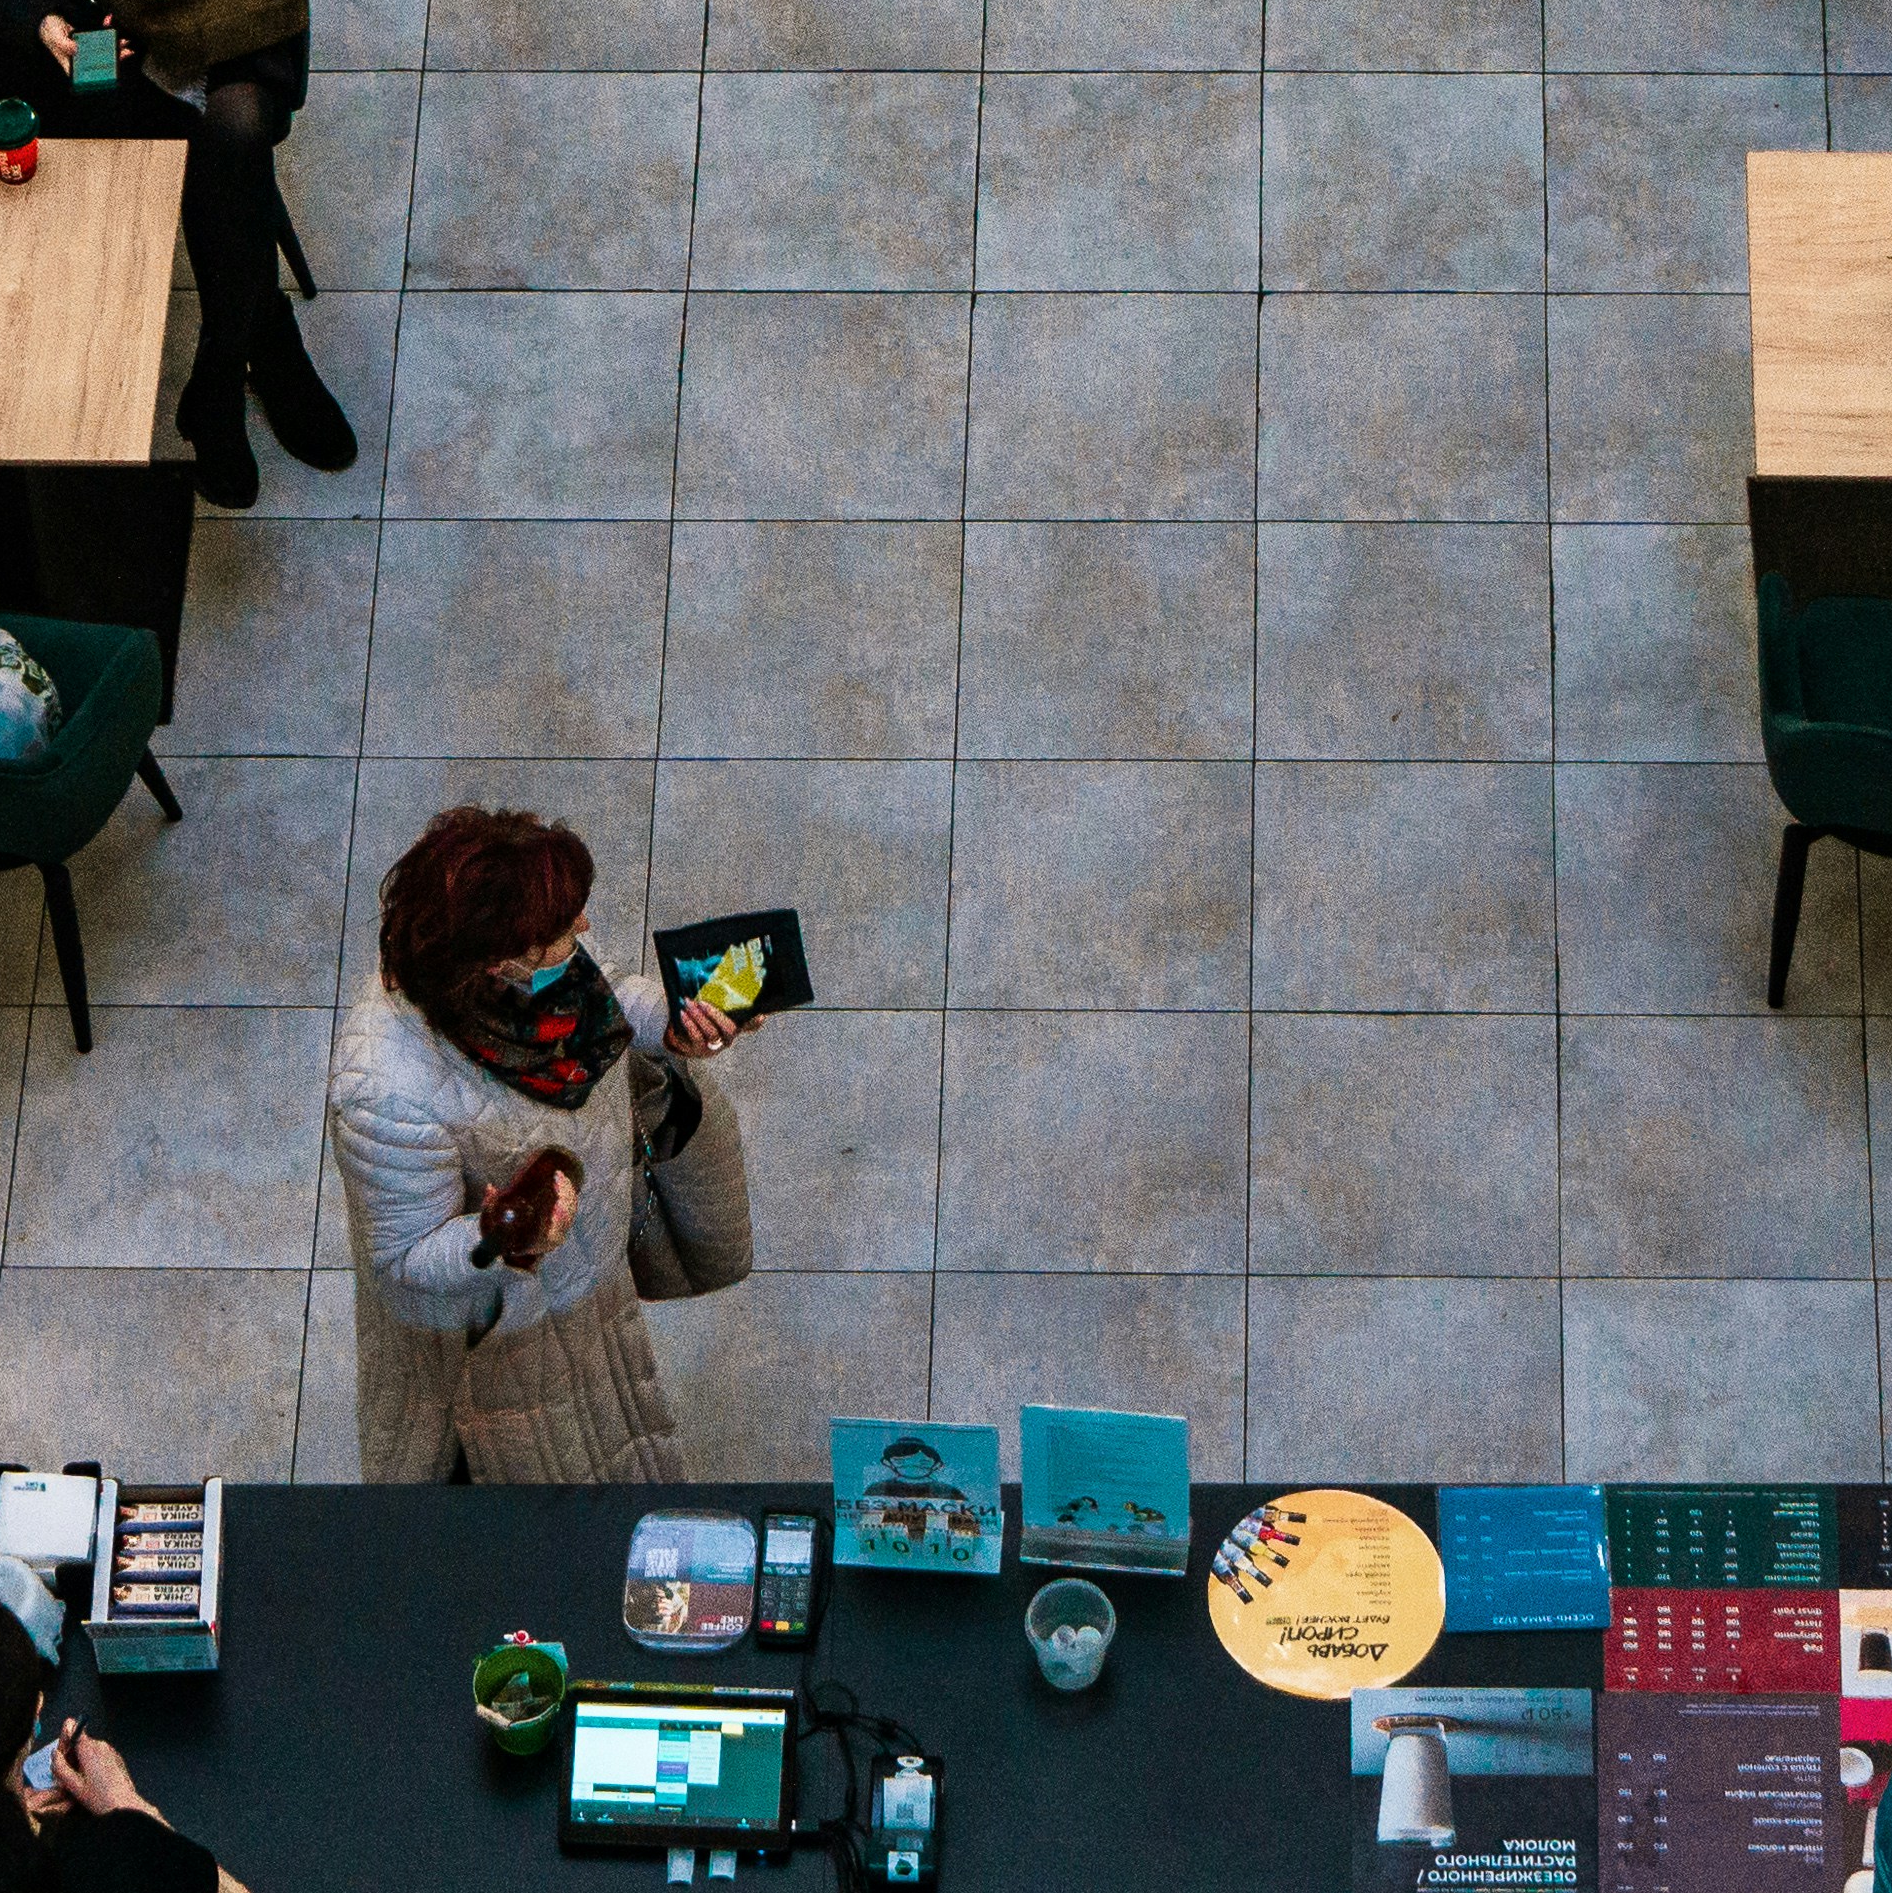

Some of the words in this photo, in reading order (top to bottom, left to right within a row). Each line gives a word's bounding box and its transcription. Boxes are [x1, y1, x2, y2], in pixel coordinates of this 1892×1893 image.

[836, 1499, 887, 1511] БЕЗ
[898, 1501, 997, 1517] МАСКИ
[161, 1512, 199, 1520] CHIKA
[164, 1540, 202, 1548] CHIKA
[1779, 1551, 1821, 1560] Горячий
[158, 1561, 196, 1569] CHIKA
[1773, 1563, 1821, 1572] Эспрессо
[1764, 1574, 1821, 1583] Американо
[154, 1594, 192, 1602] CHIKA
[722, 1615, 744, 1623] LIKE
[1793, 1619, 1823, 1628] Латте
[701, 1622, 744, 1631] COFFEE
[1279, 1626, 1359, 1645] СИРОП!
[1773, 1630, 1823, 1640] Капучино
[1790, 1763, 1821, 1772] груша
[1503, 1838, 1576, 1852] МОЛОКА
[1747, 1844, 1786, 1853] молоко
[1435, 1854, 1577, 1868] РАСТИТЕЛЬНОГО
[1427, 1869, 1578, 1884] ОБЕЗЖИРЕННОГО
